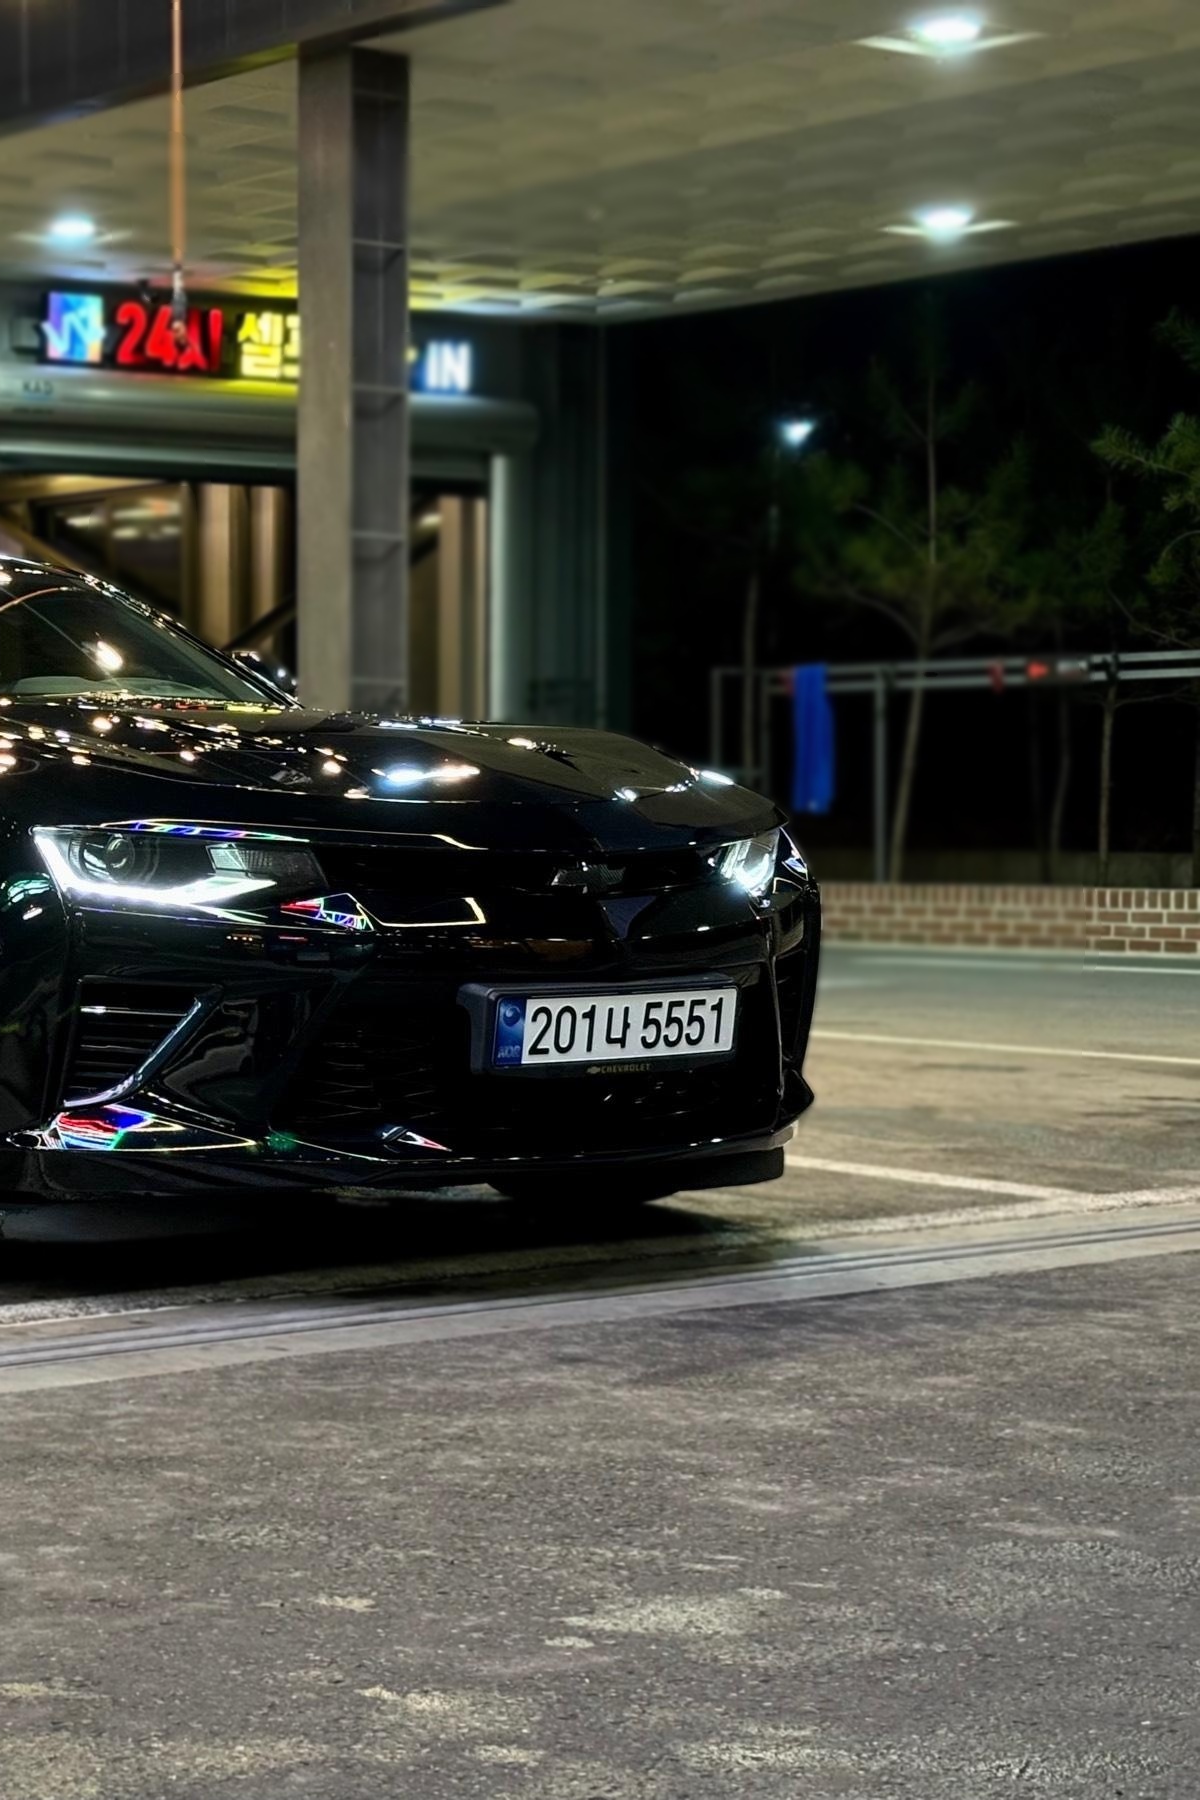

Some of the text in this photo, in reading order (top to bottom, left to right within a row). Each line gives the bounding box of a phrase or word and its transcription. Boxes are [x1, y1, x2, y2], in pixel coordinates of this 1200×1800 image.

[117, 302, 223, 373] 24시
[426, 340, 471, 390] IN
[528, 997, 724, 1056] 201나 5551
[601, 1063, 651, 1074] CHEVROLET
